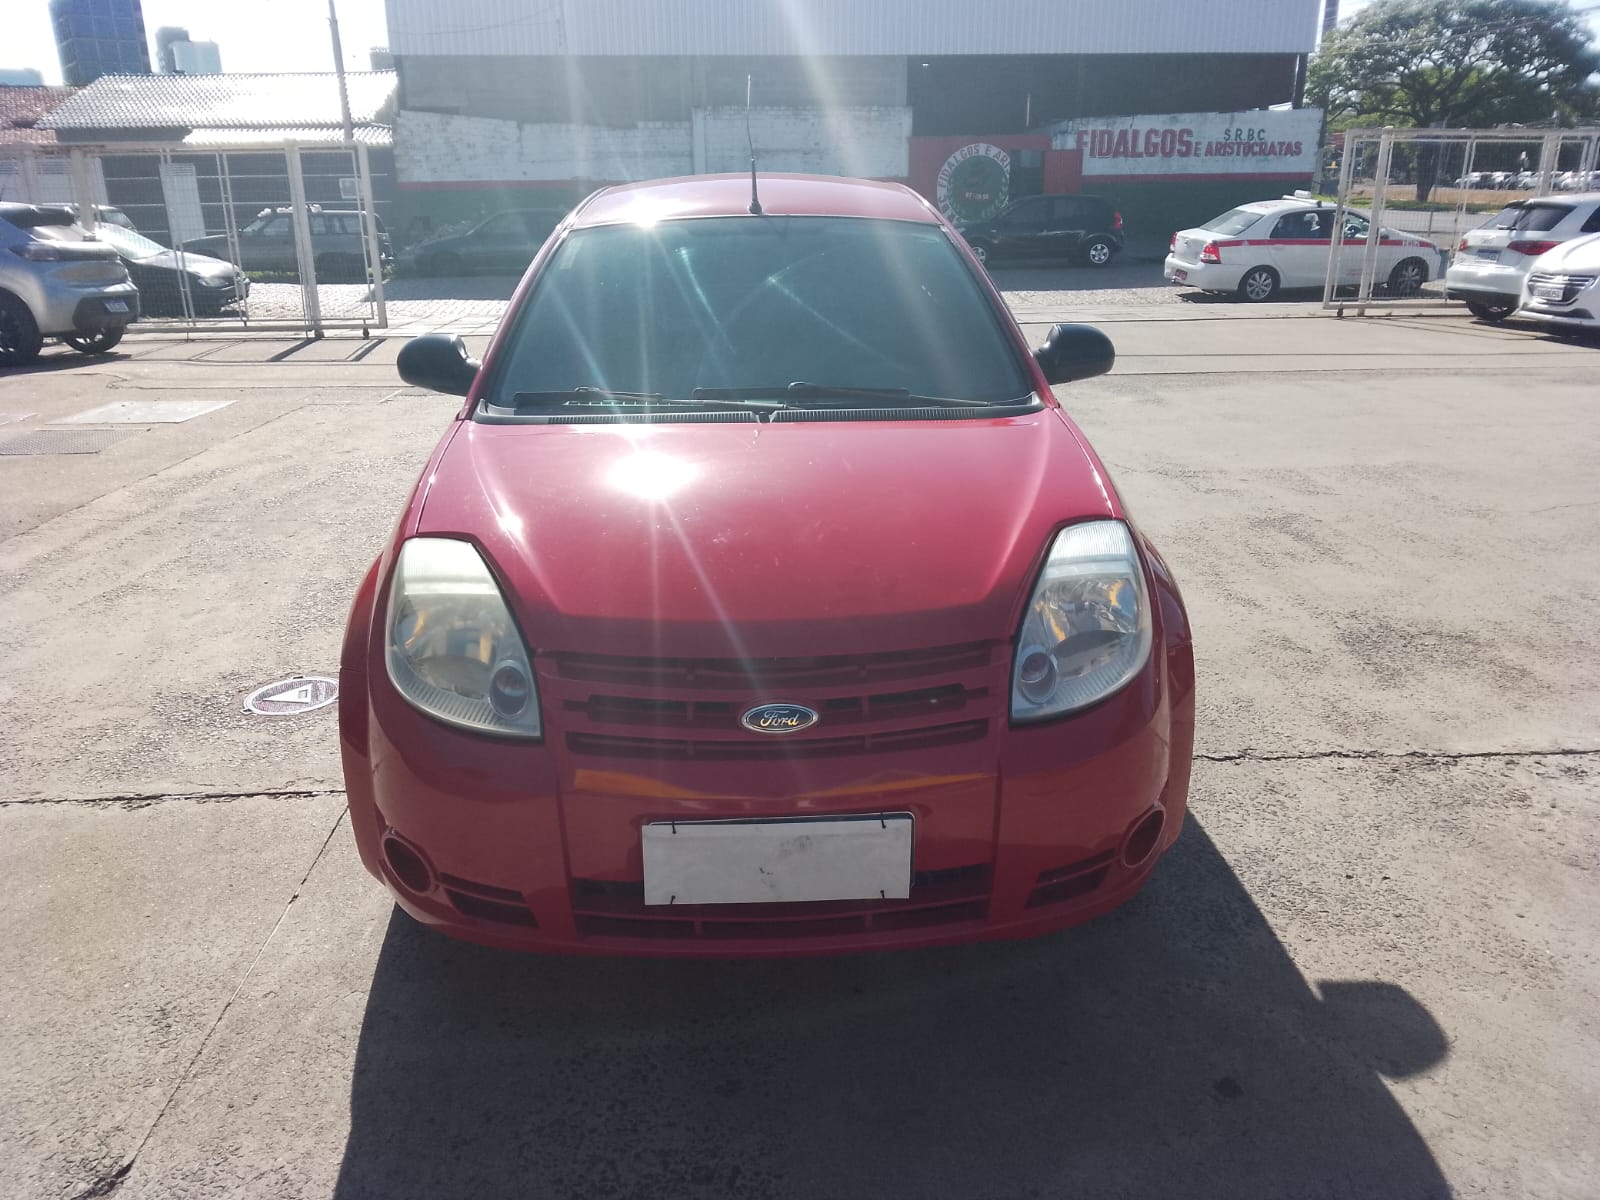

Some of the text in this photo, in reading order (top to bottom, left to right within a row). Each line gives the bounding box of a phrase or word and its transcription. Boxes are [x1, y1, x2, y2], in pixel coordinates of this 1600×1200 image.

[1076, 128, 1303, 159] FIDALGOS E ARISTOCRATAS
[760, 710, 800, 727] Ford
